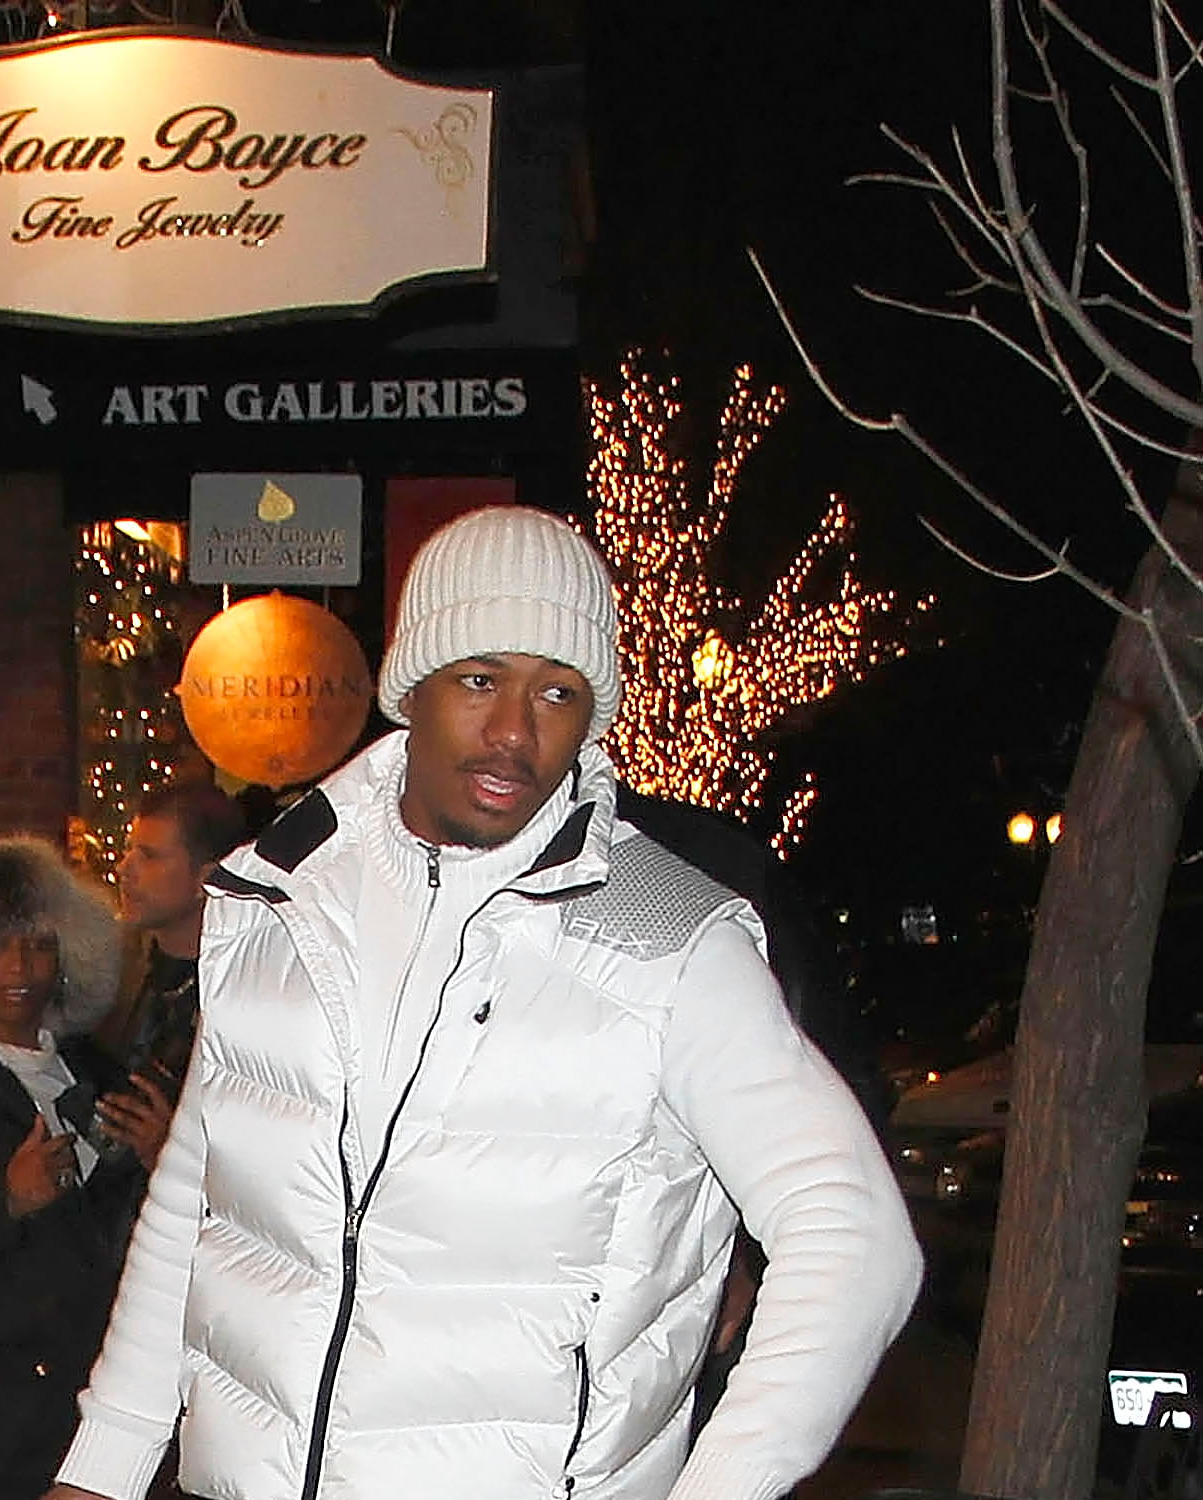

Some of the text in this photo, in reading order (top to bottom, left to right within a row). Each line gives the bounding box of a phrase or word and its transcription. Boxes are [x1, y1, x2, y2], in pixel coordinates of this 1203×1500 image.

[138, 105, 368, 190] Boyce
[12, 196, 285, 249] Fine Jewelry
[102, 377, 527, 424] ART GALLERIES
[206, 548, 346, 568] FINE ARTS
[191, 674, 362, 697] MERIDIAN
[568, 916, 652, 954] RLX
